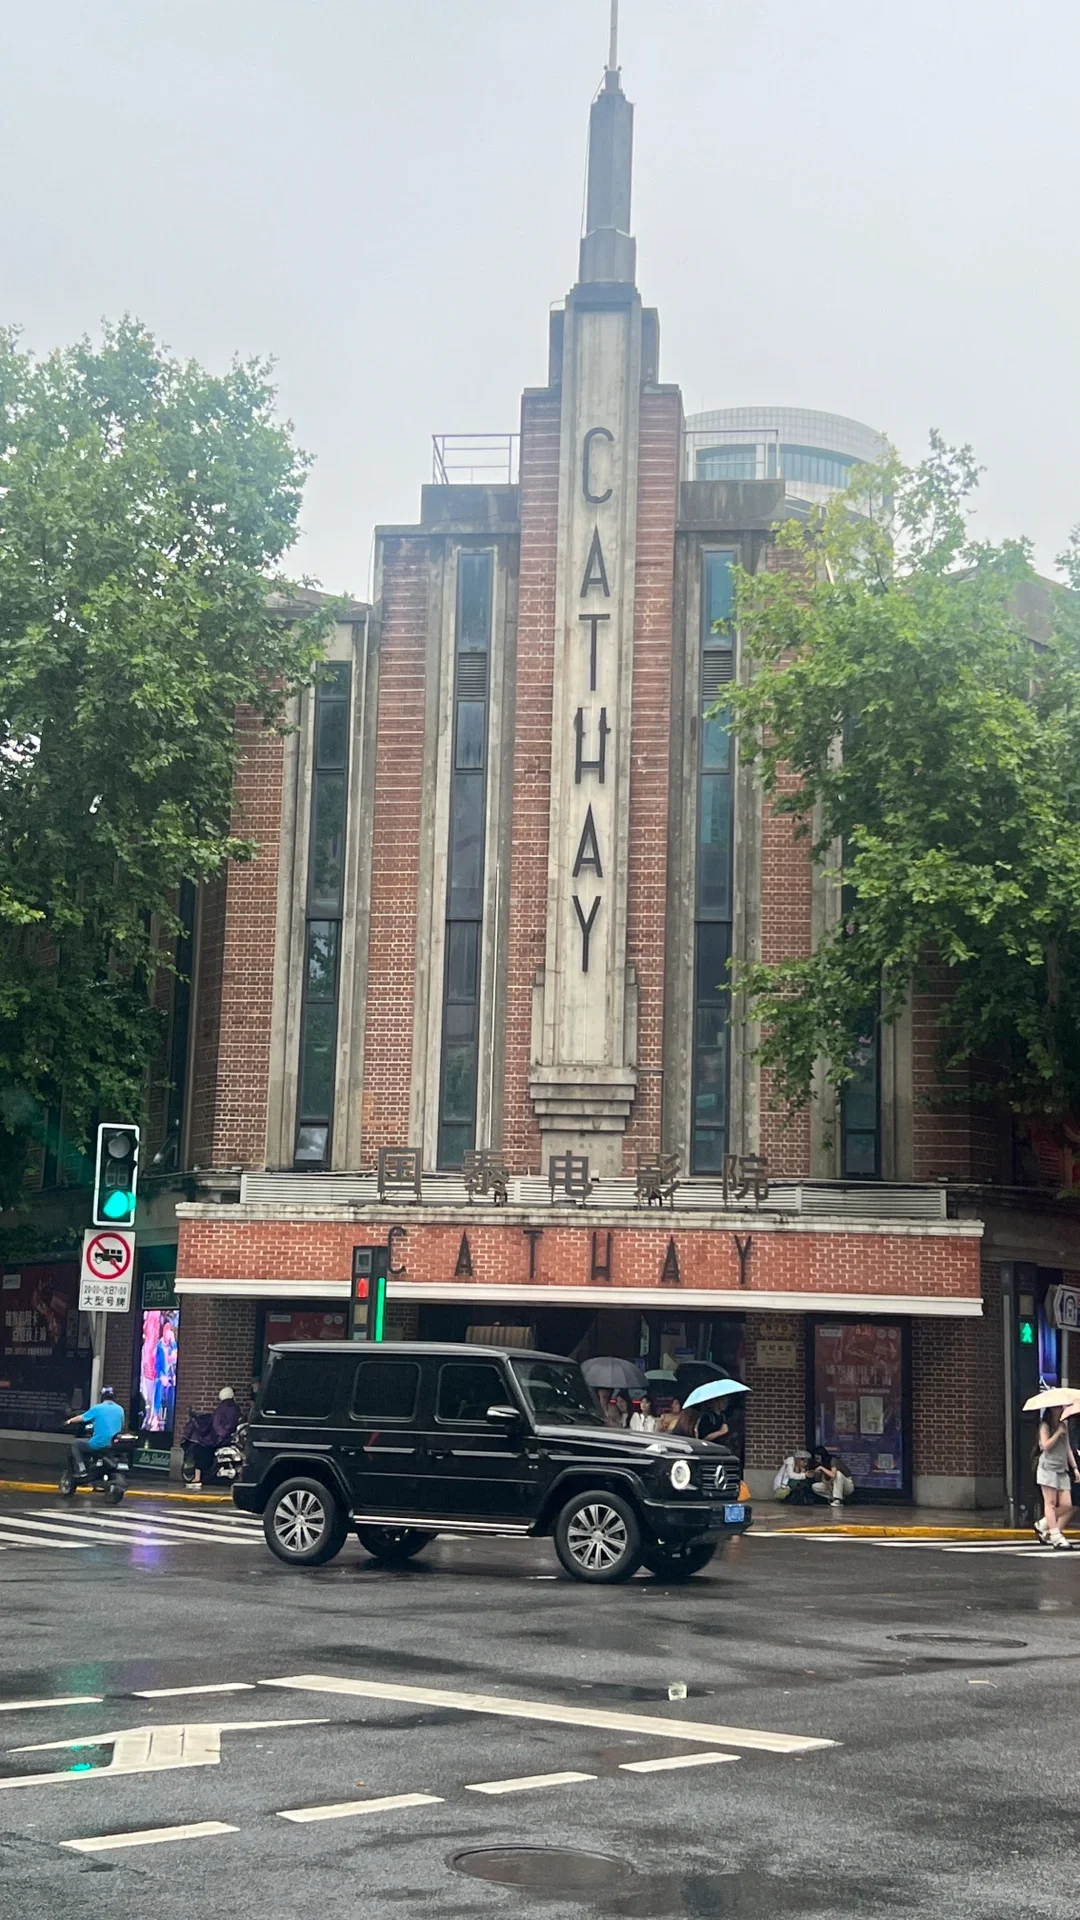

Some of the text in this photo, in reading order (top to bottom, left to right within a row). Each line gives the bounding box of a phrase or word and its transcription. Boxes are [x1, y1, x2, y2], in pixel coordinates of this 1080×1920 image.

[571, 426, 615, 974] CATHAY
[376, 1146, 770, 1201] 国泰电影院
[387, 1226, 753, 1286] CATHAY
[83, 1295, 126, 1307] 大型号牌
[144, 1290, 170, 1302] EATERY
